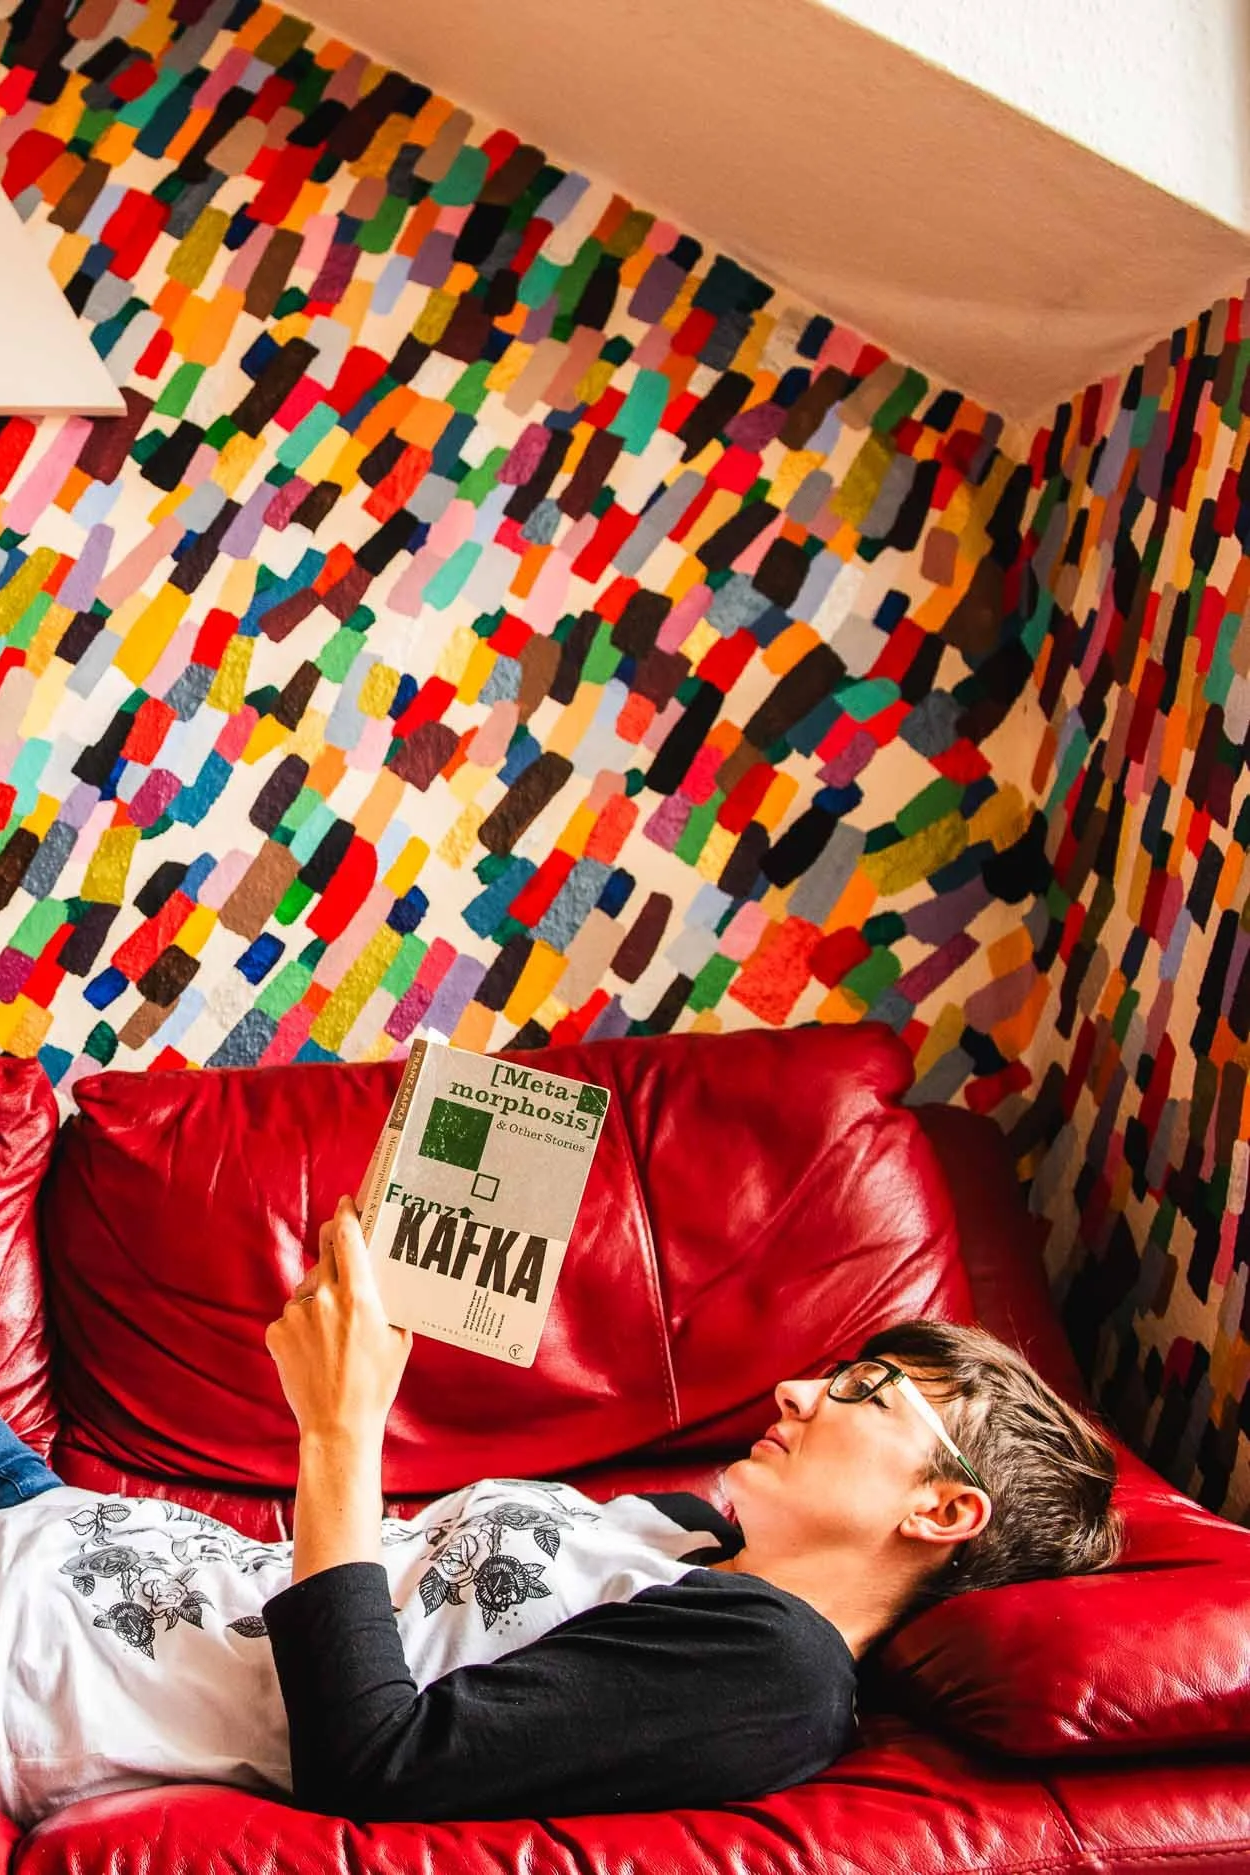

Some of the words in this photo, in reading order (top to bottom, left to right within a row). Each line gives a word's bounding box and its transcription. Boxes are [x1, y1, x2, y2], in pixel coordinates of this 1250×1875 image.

[406, 1051, 422, 1086] FRANZ
[490, 1063, 579, 1101] [Meta-
[394, 1087, 412, 1122] KAFKA
[449, 1081, 601, 1140] morphosis]
[496, 1120, 507, 1131] &
[509, 1123, 543, 1142] Other
[544, 1133, 585, 1153] Stories
[385, 1182, 457, 1218] Franz
[388, 1206, 549, 1304] KAFKA
